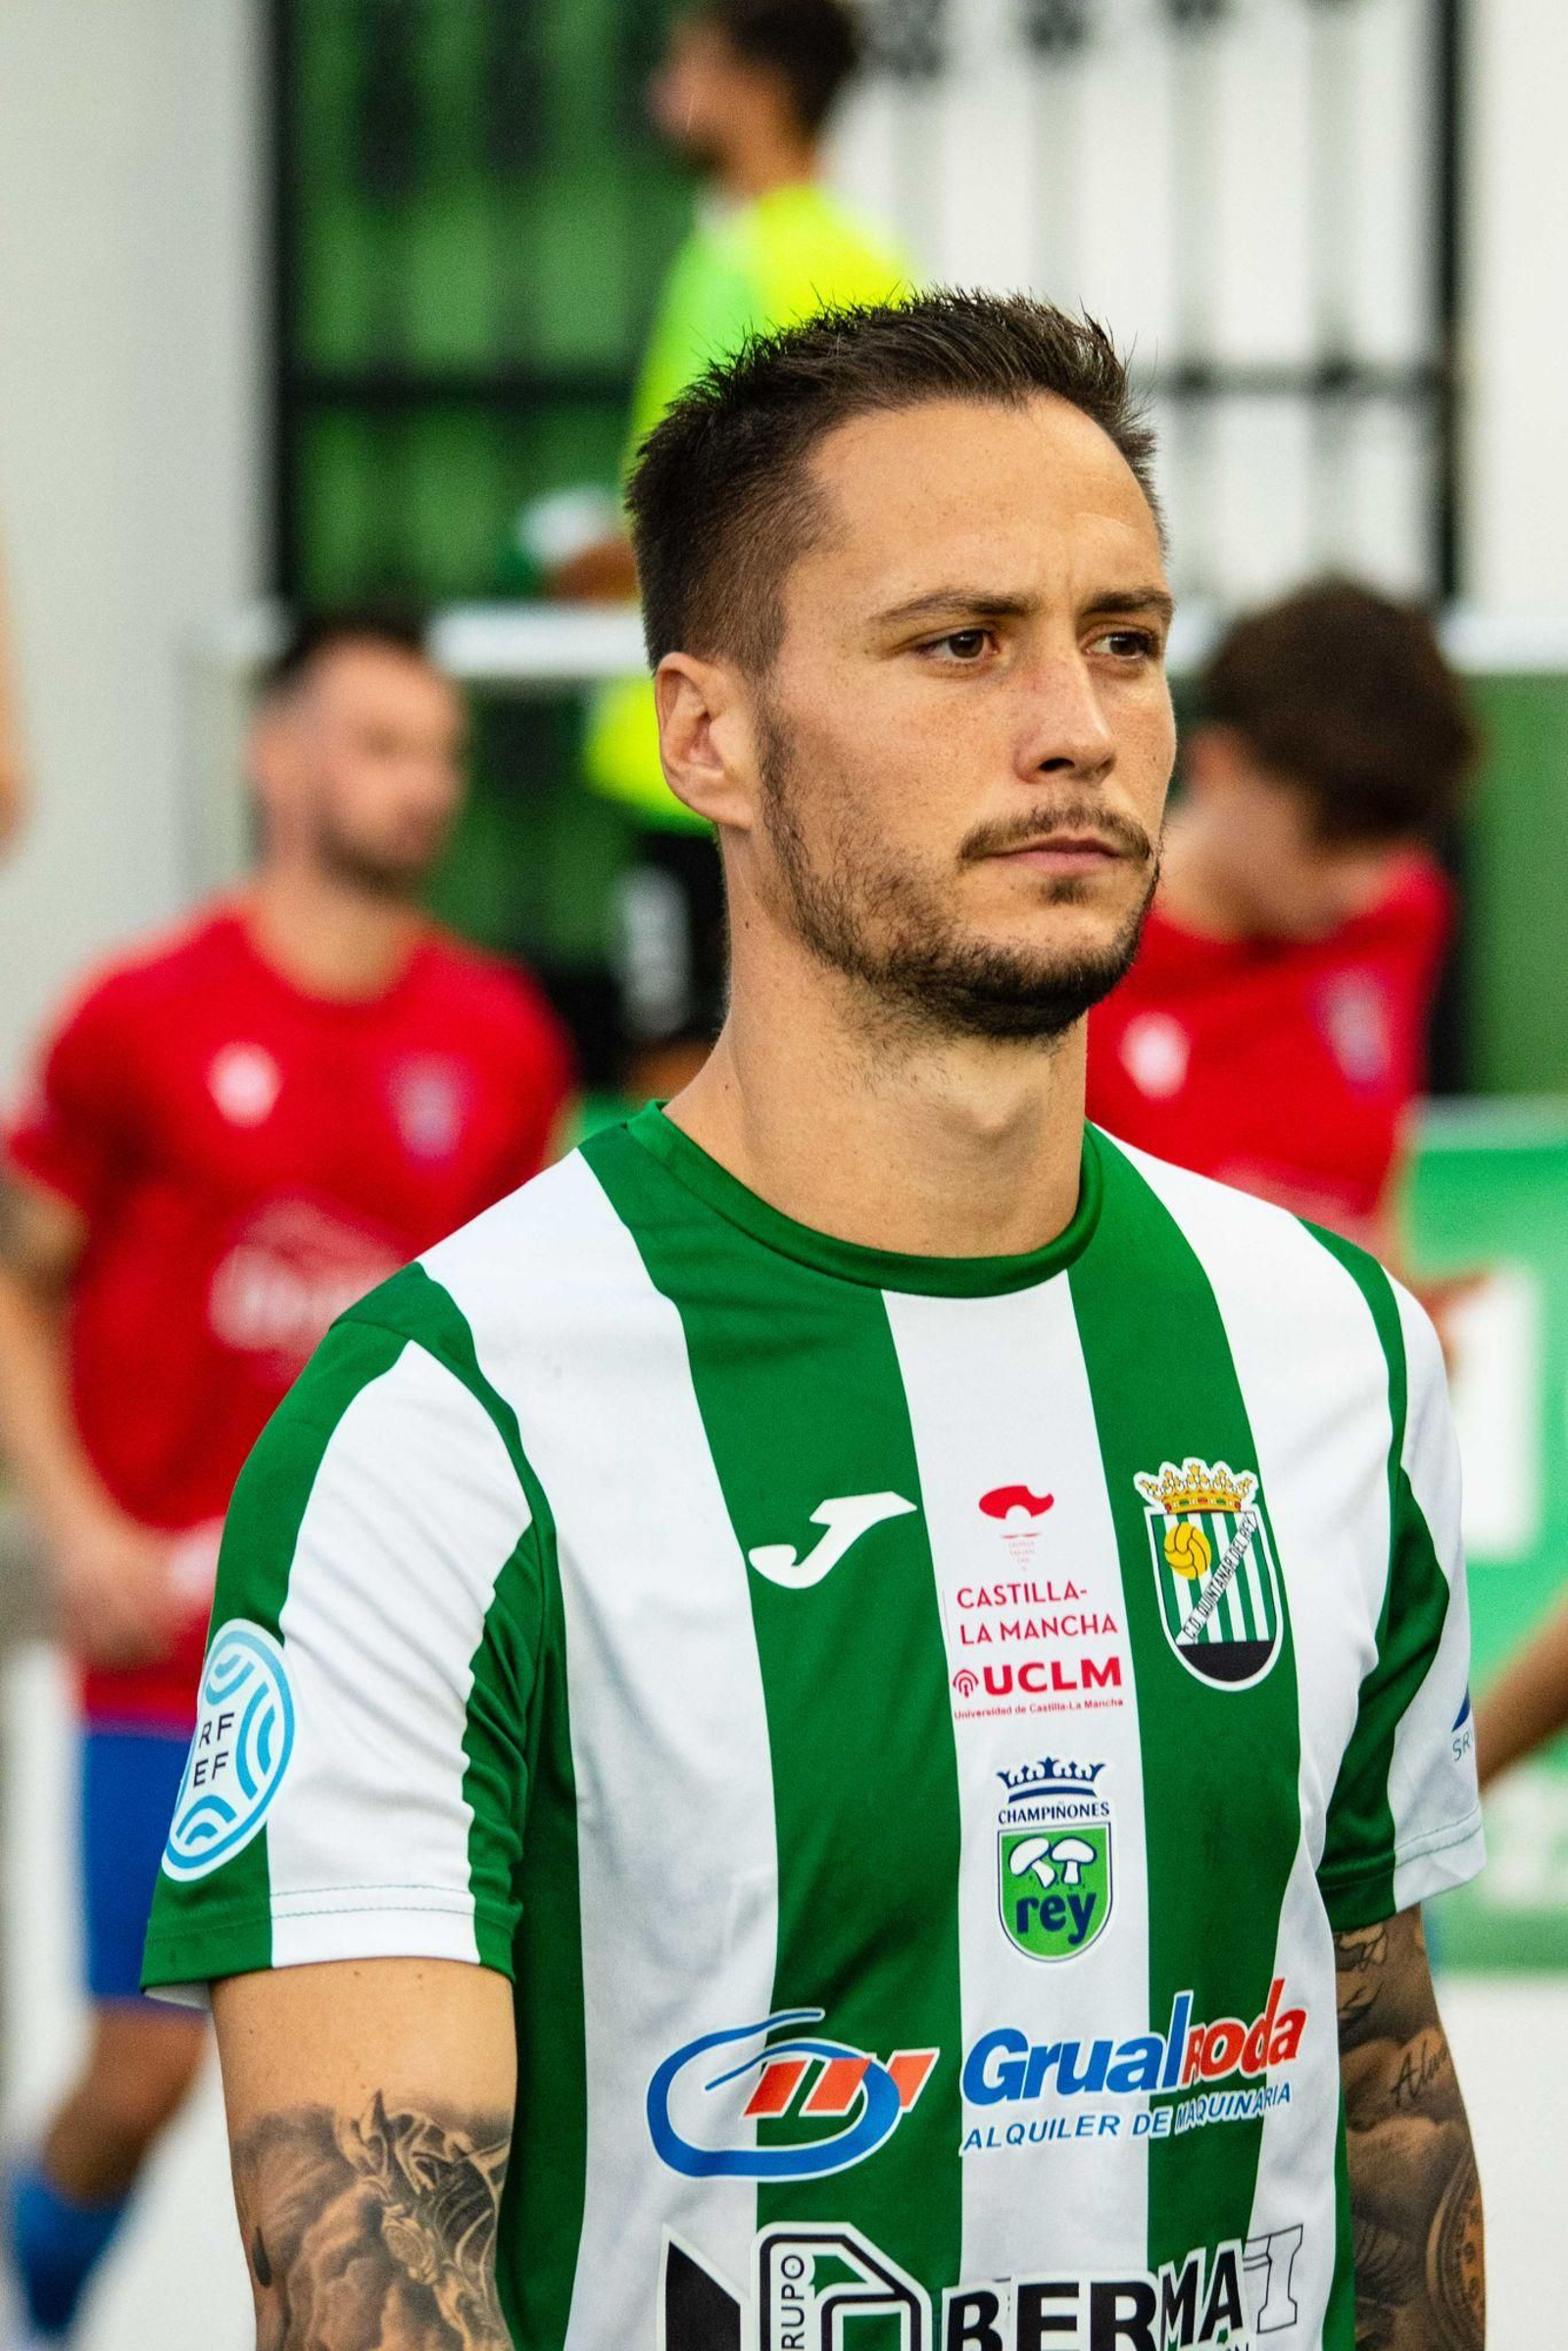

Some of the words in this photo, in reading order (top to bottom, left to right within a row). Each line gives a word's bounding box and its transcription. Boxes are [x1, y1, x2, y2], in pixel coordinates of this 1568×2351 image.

[956, 1580, 1088, 1609] CASTILLA-
[960, 1623, 993, 1645] LA
[1001, 1613, 1118, 1641] MANCHA
[983, 1656, 1122, 1696] UCLM
[954, 1705, 1013, 1721] Universidad
[1015, 1704, 1027, 1714] de
[1084, 1697, 1124, 1709] Mancha
[198, 1712, 235, 1749] RF
[193, 1750, 229, 1788] EF
[998, 1800, 1110, 1825] CHAMPIÑONES
[1015, 1891, 1097, 1945] rey
[963, 2114, 1121, 2151] ALQUILER
[1132, 2110, 1170, 2136] DE
[1176, 2083, 1291, 2128] MAQUINARIA
[948, 2248, 1244, 2351] BERMA
